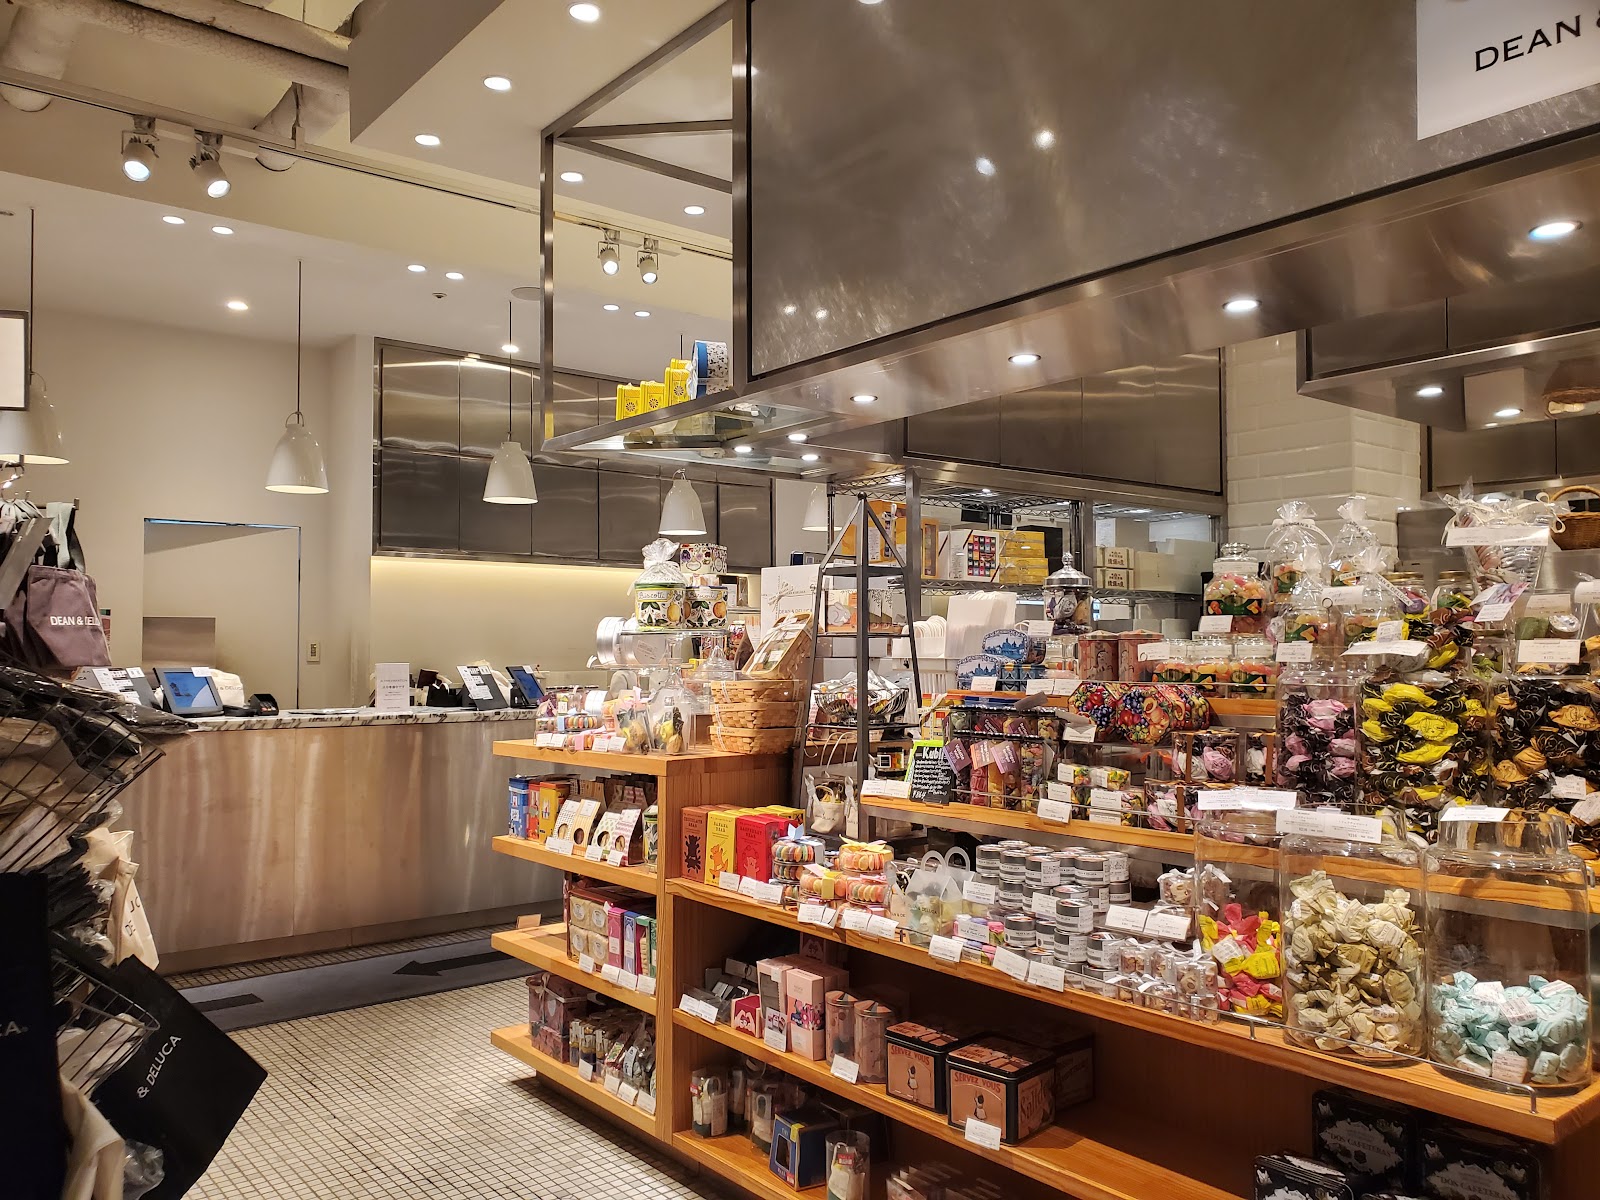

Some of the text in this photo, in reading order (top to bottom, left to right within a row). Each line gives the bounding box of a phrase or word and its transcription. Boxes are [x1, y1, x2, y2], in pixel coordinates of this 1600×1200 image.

[1474, 15, 1582, 72] DEAN
[50, 616, 75, 626] DEAN
[76, 616, 84, 626] &
[891, 1044, 930, 1065] SERVEZ VOUS
[137, 1035, 182, 1098] & DELUCA
[954, 1072, 1001, 1094] SERVEZ VOUS
